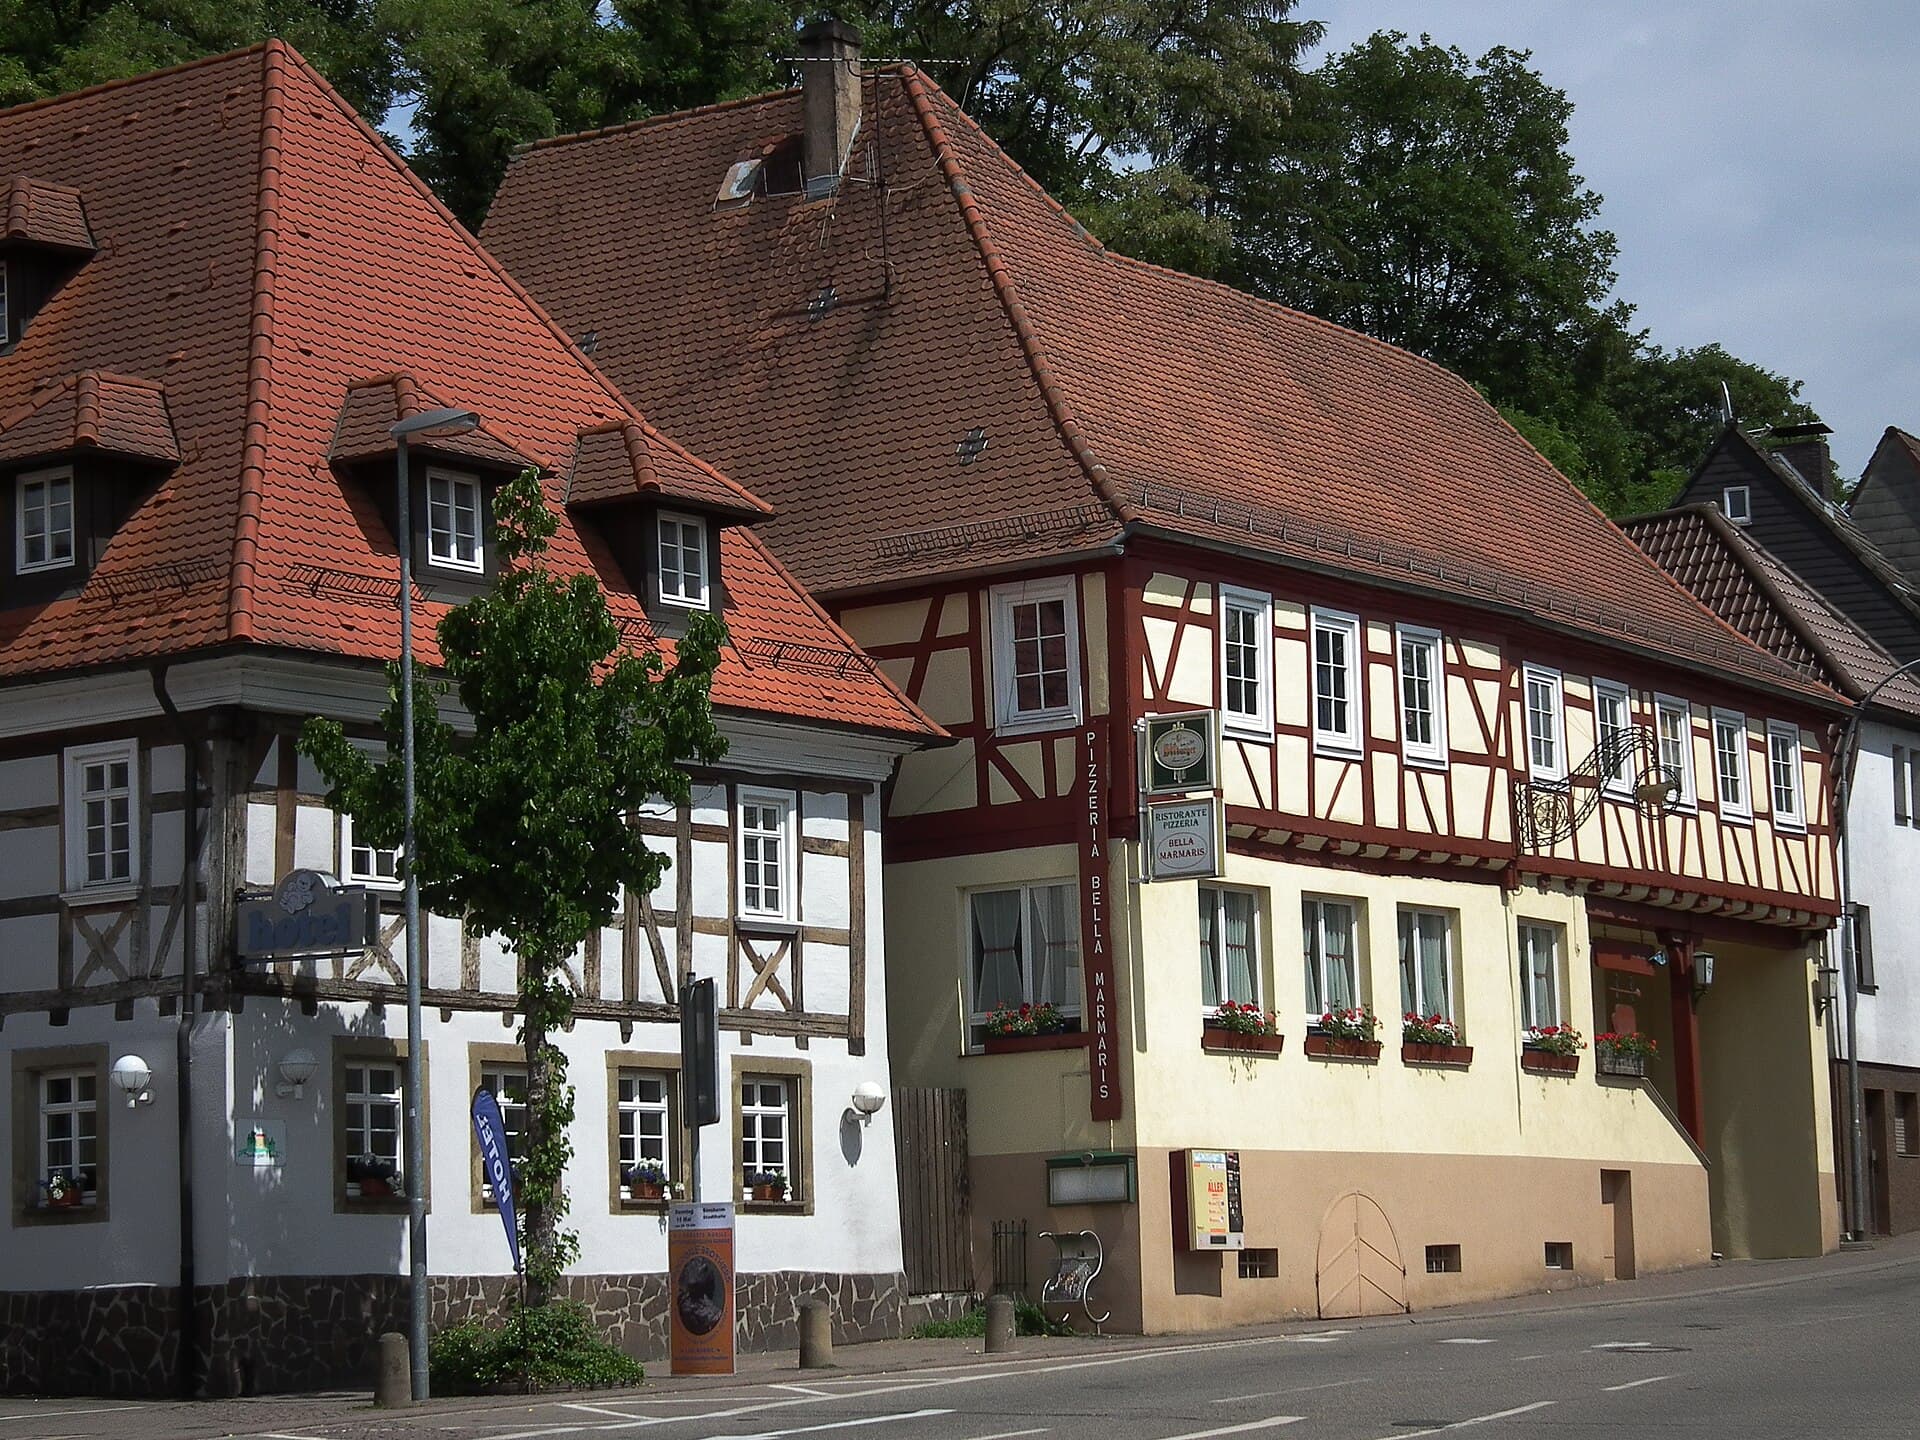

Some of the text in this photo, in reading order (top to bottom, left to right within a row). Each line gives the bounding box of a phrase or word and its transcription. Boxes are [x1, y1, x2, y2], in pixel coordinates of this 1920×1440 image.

[1155, 808, 1207, 822] RISTORANTE
[1163, 818, 1199, 829] PIZZERIA
[1168, 837, 1195, 848] BELLA
[1160, 847, 1205, 860] MARMARIS
[1087, 731, 1109, 1098] PIZZERIA BELLA MARMARIS
[248, 902, 352, 949] hotel
[1207, 1182, 1224, 1193] ALLES
